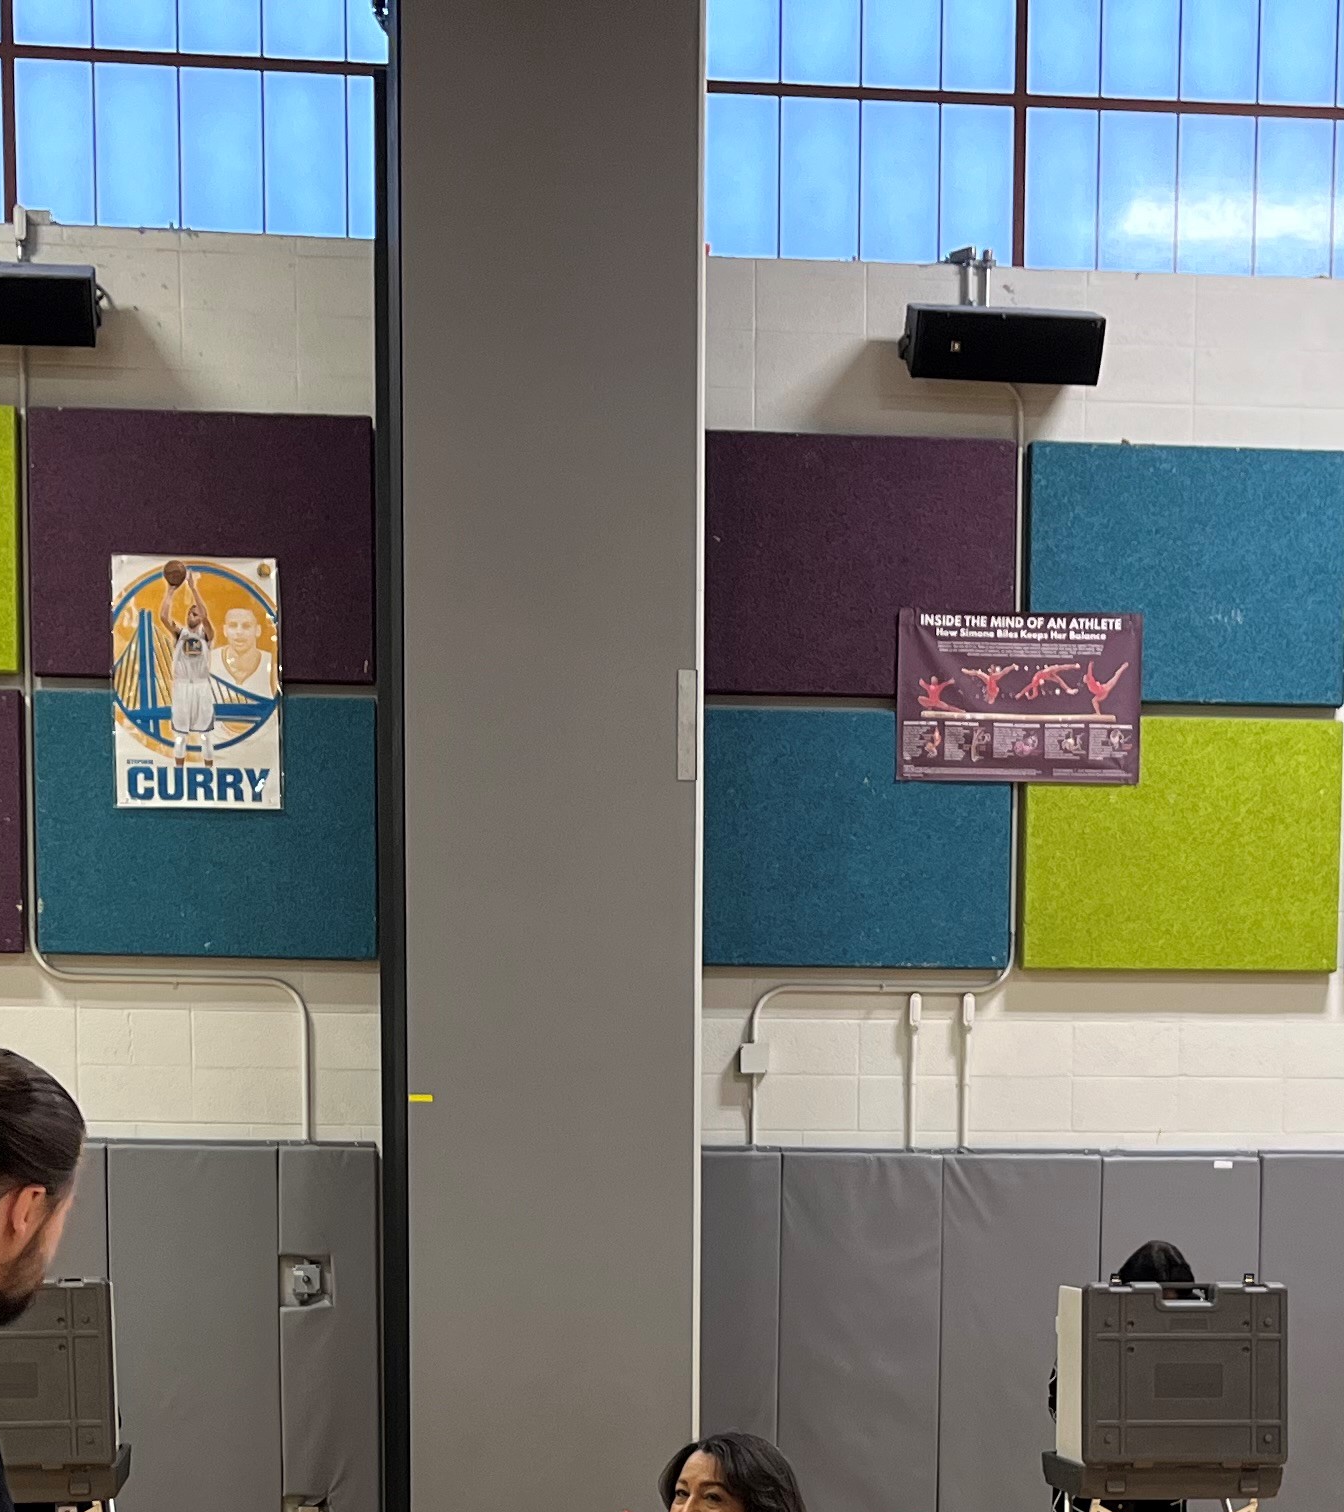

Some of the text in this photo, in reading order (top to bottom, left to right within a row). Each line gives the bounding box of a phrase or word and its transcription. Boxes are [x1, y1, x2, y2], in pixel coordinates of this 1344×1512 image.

[920, 614, 1122, 630] INSIDE THE MIND OF AN ATHLETE
[936, 627, 1107, 641] How Simone Biles Keeps Her Balance
[127, 766, 270, 802] CURRY
